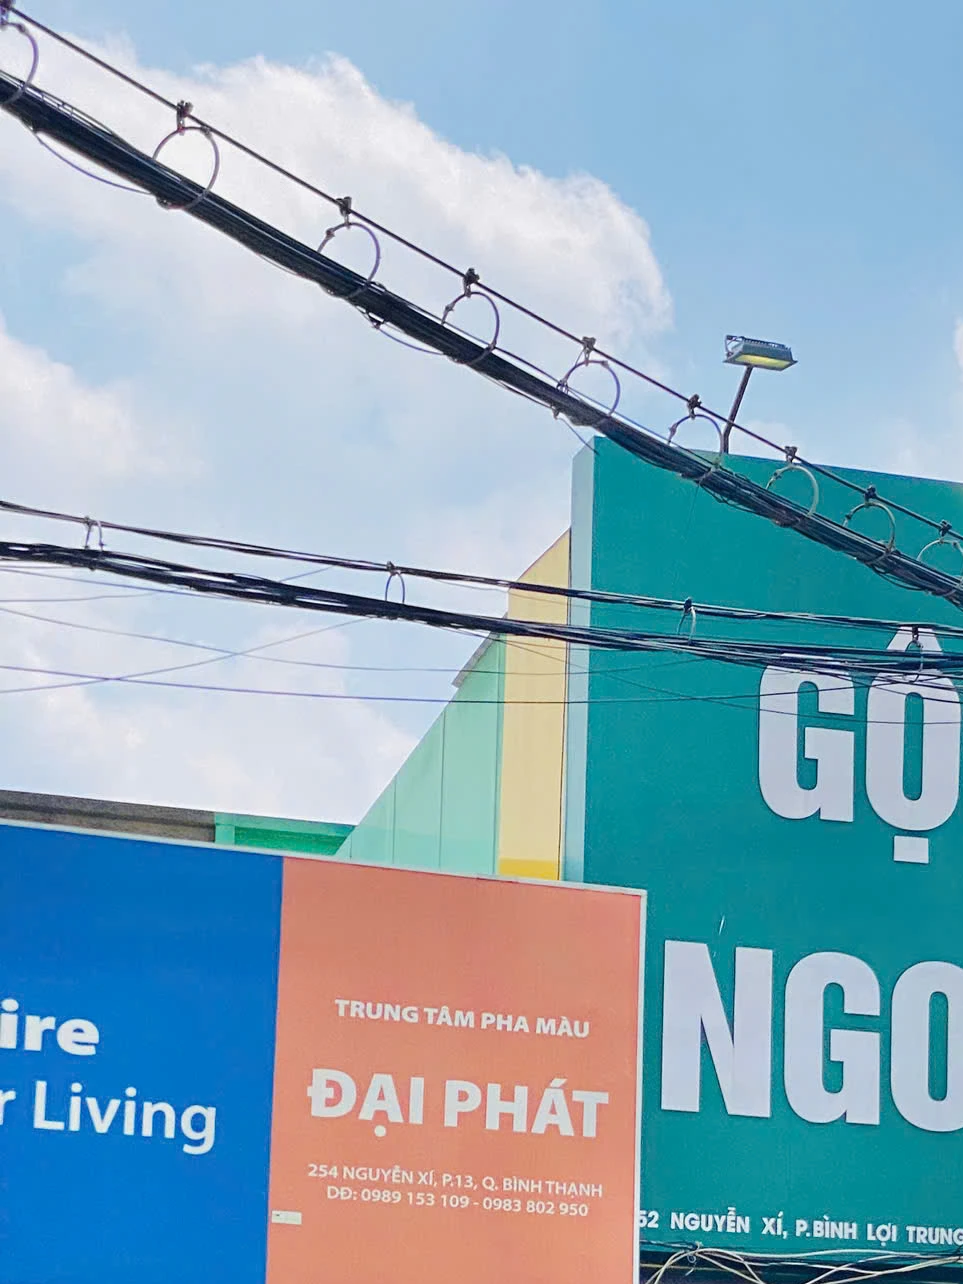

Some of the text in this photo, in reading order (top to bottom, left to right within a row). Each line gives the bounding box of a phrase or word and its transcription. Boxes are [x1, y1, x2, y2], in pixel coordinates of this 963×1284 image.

[335, 999, 589, 1038] TRUNG TÂM PHA MÀU
[33, 1080, 217, 1155] Living
[307, 1068, 609, 1137] ĐẠI PHÁT
[308, 1164, 602, 1198] 254 NGUYỄN XÍ, P.13, Q. BÌNH THẠNH
[327, 1186, 357, 1200] DĐ:
[361, 1189, 401, 1203] 0989
[407, 1192, 435, 1206] 153
[441, 1195, 470, 1208] 109
[483, 1197, 521, 1212] 0983
[526, 1200, 555, 1214] 802
[559, 1203, 588, 1216] 950
[670, 1207, 750, 1233] NGUYỄN
[761, 1211, 788, 1239] XÍ,
[795, 1215, 857, 1240] P.BÌNH
[866, 1223, 897, 1246] LỢI
